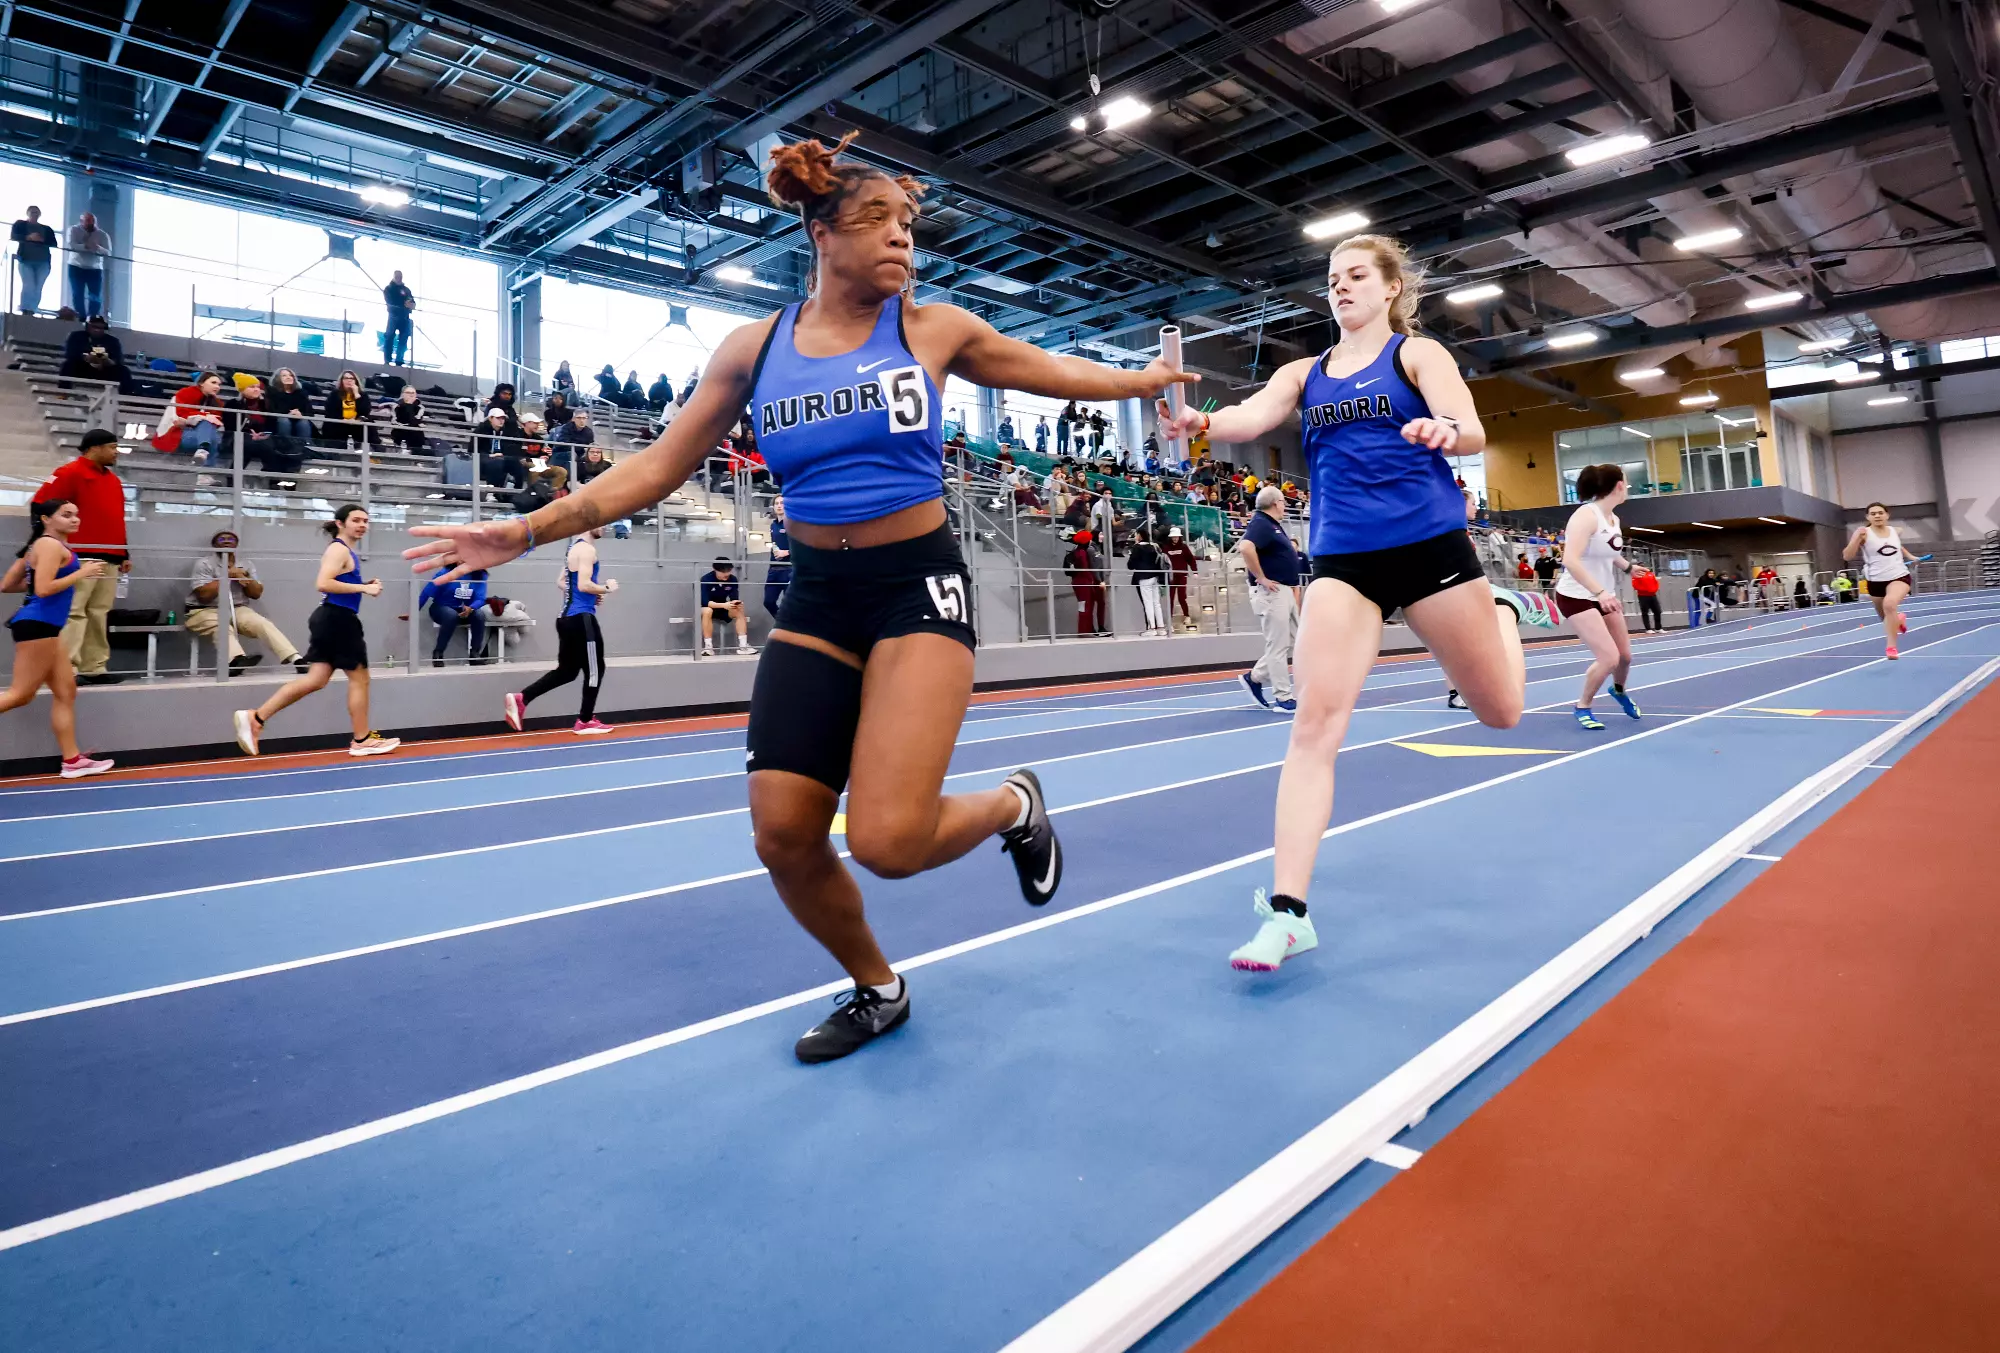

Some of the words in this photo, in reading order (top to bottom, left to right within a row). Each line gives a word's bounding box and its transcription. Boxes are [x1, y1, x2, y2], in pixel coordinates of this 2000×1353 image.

[761, 381, 888, 437] AUROR
[891, 371, 923, 427] 5
[934, 574, 963, 621] 5
